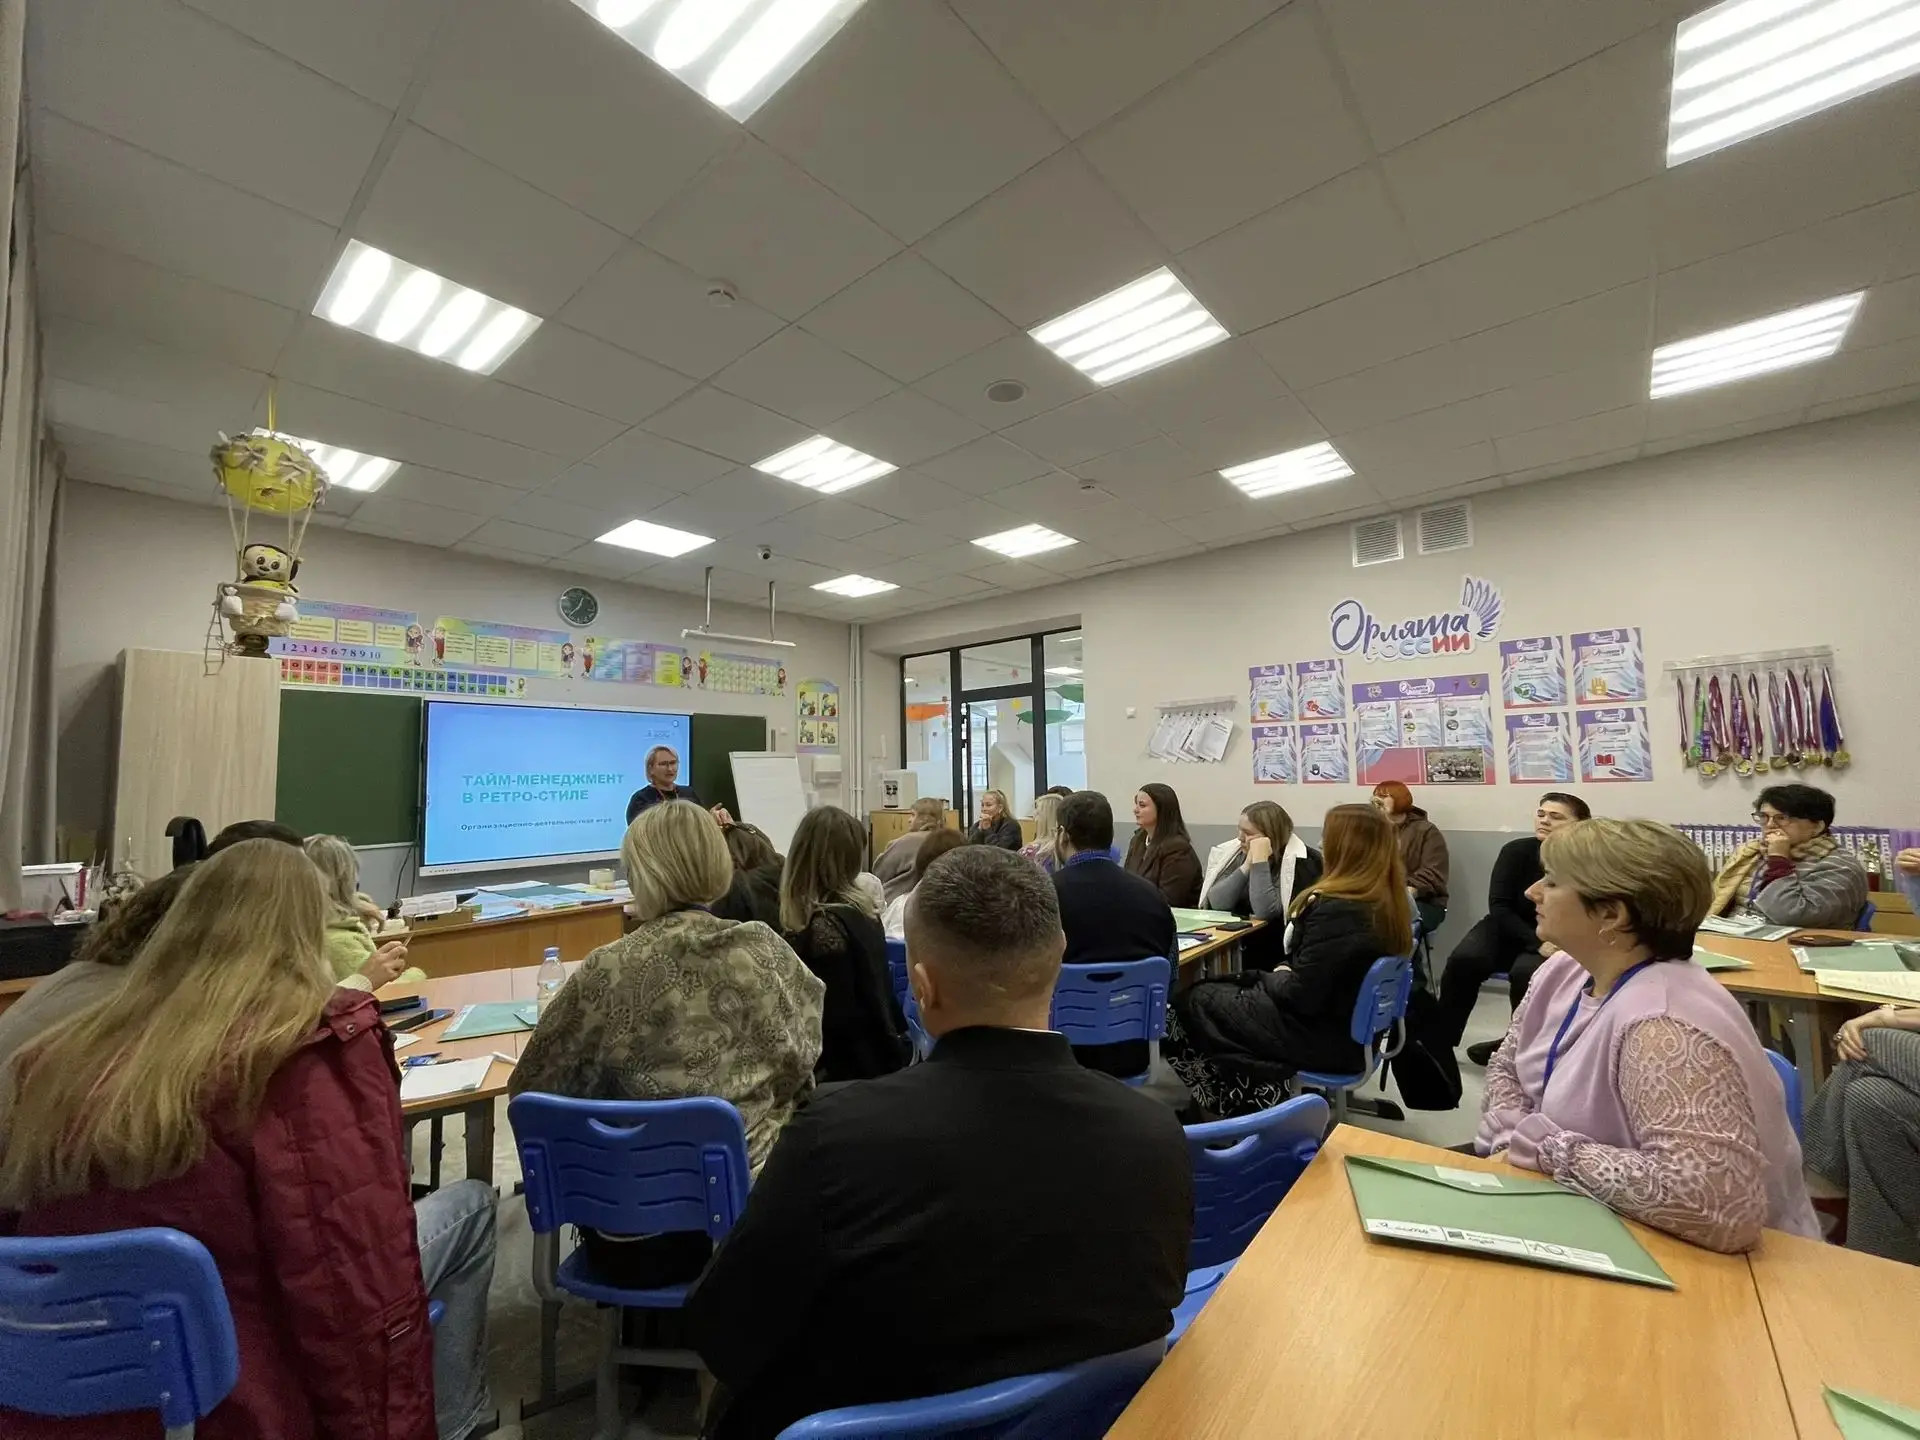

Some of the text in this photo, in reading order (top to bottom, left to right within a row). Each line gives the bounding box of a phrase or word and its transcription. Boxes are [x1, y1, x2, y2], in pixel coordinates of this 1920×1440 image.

[1330, 599, 1470, 654] Орлята
[462, 772, 625, 787] ТАЙМ-МЕНЕДЖМЕНТ
[462, 790, 589, 804] В РЕТРО-СТИЛЕ
